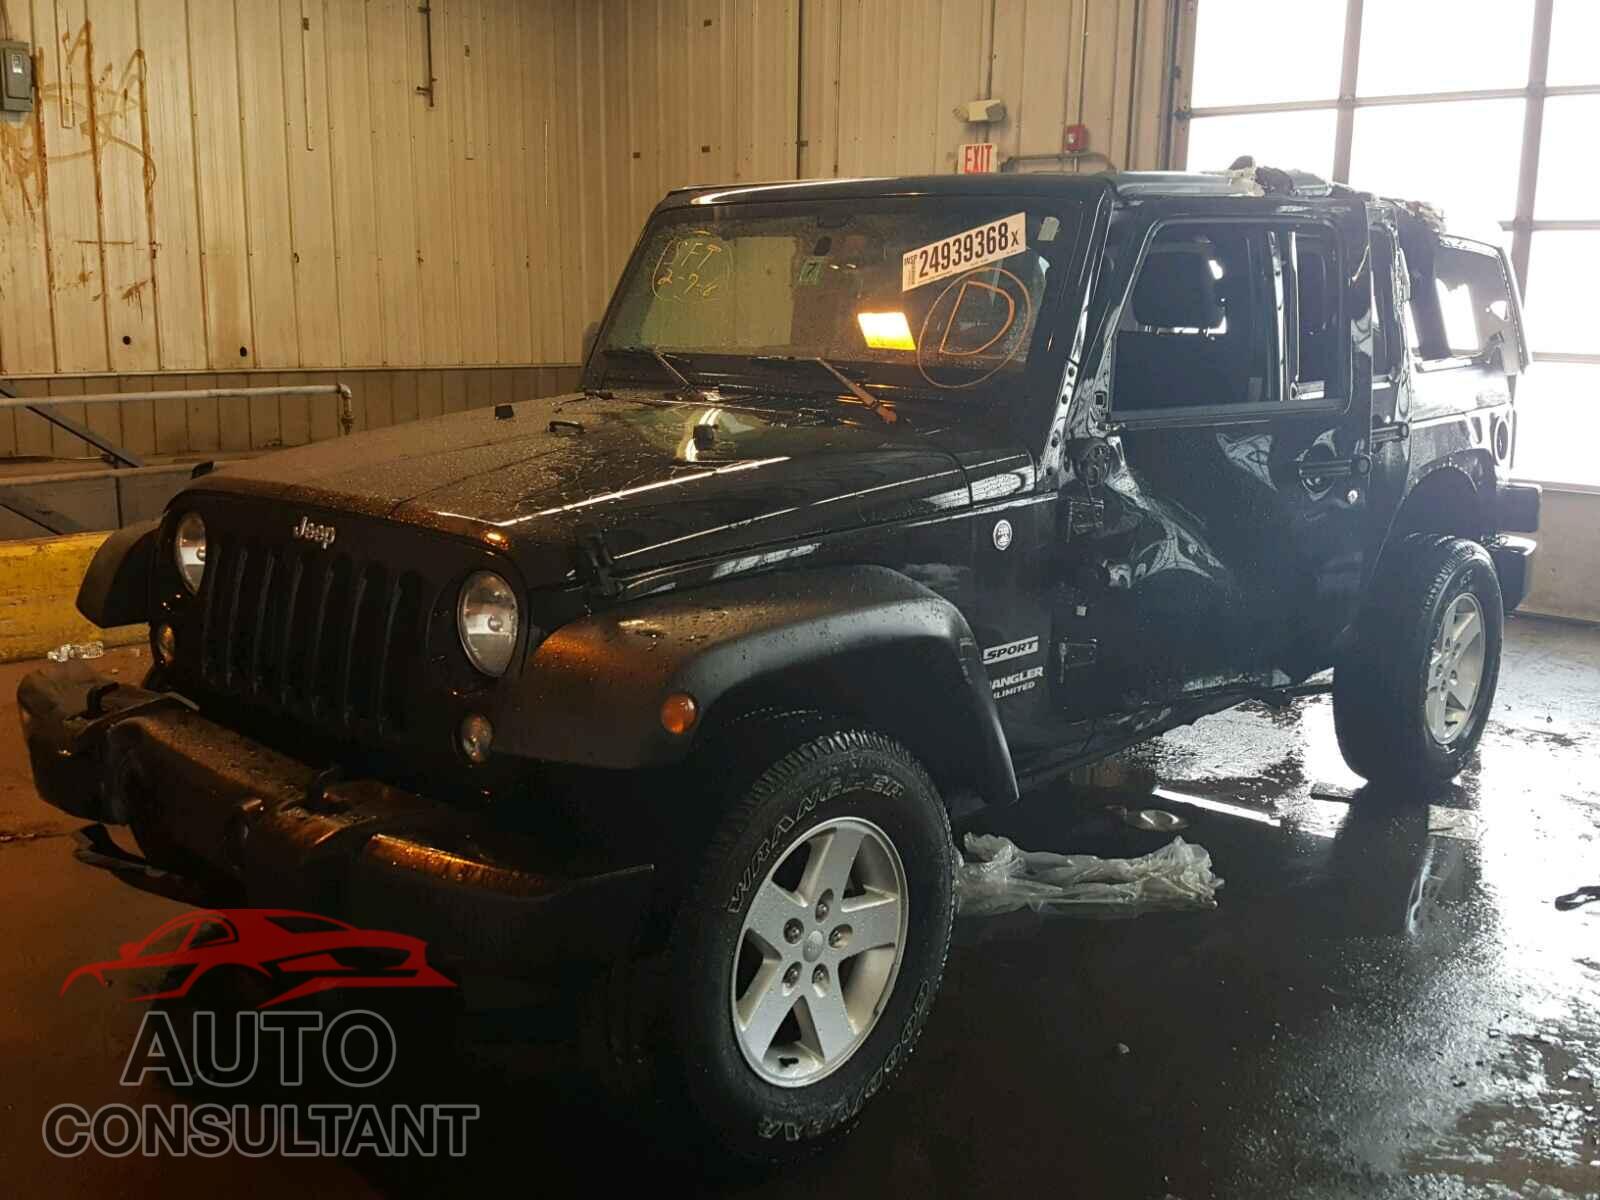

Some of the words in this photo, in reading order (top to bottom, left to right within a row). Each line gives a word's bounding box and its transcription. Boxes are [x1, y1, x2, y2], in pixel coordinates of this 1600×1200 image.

[964, 144, 993, 173] EXIT
[918, 222, 1009, 279] 24939368
[294, 516, 336, 550] Jeep
[984, 640, 1037, 660] SPORT
[991, 666, 1044, 690] ANGLER
[993, 680, 1036, 699] LIMITED
